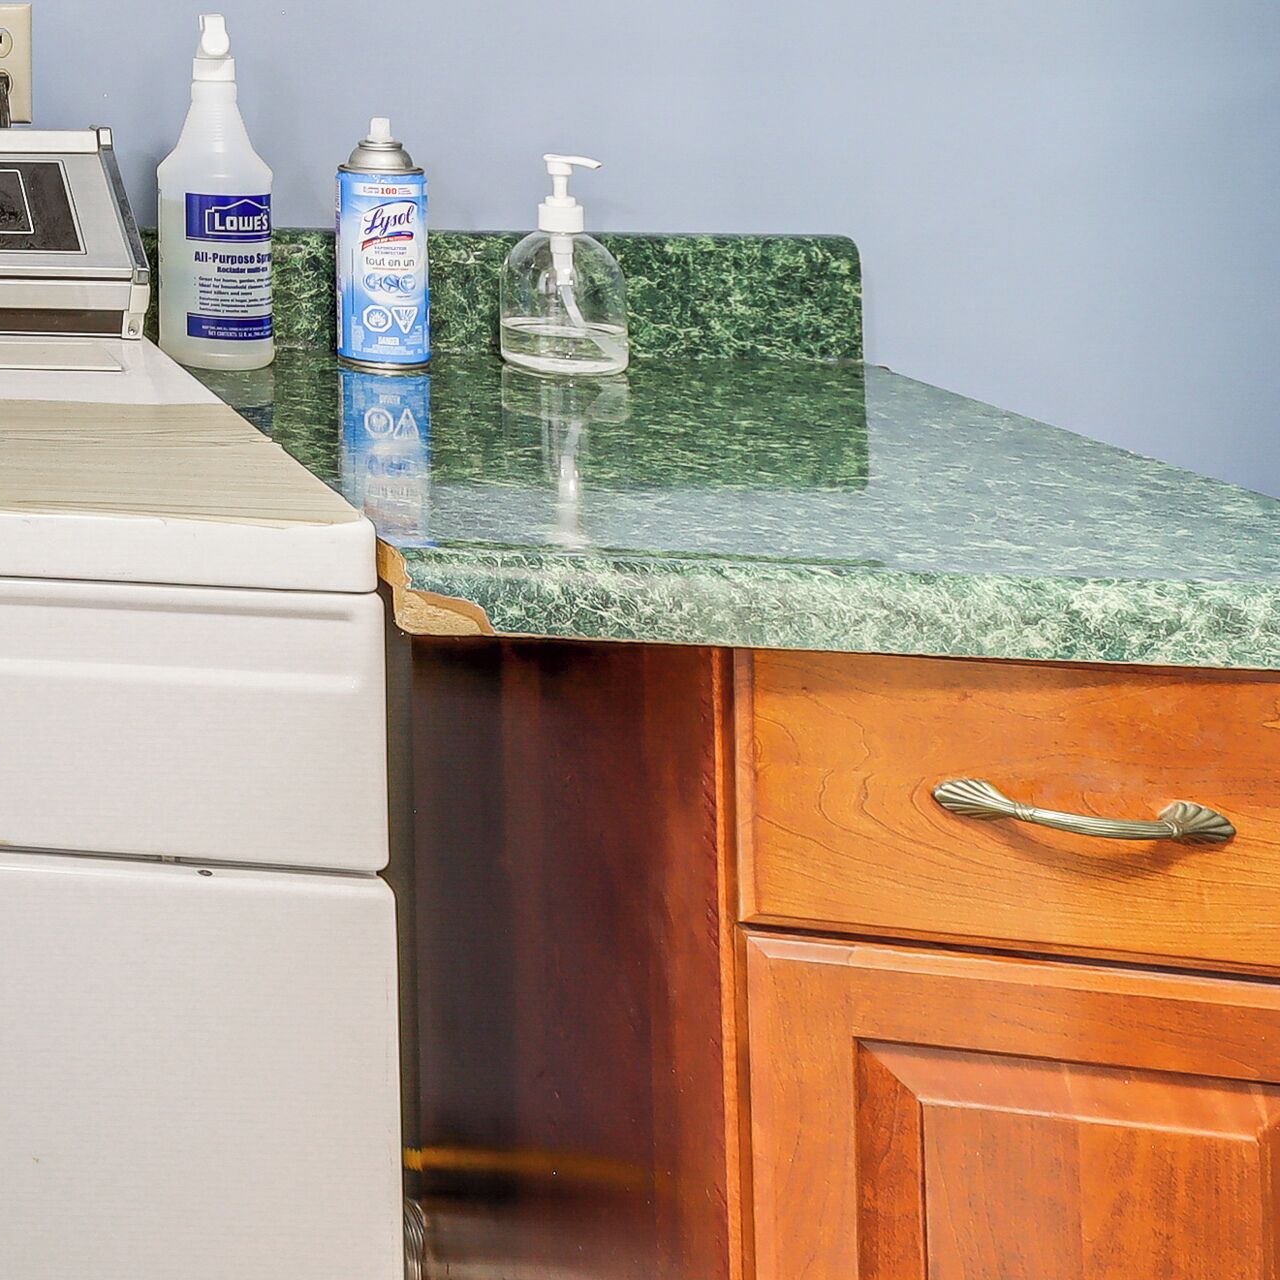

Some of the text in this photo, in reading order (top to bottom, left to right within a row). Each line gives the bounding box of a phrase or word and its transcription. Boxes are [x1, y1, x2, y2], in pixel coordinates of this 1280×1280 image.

[381, 187, 397, 195] 100
[214, 212, 268, 231] LOWE'S
[364, 205, 415, 236] Lysol
[194, 251, 272, 265] All-Purpose Spra
[365, 256, 415, 267] tout en un
